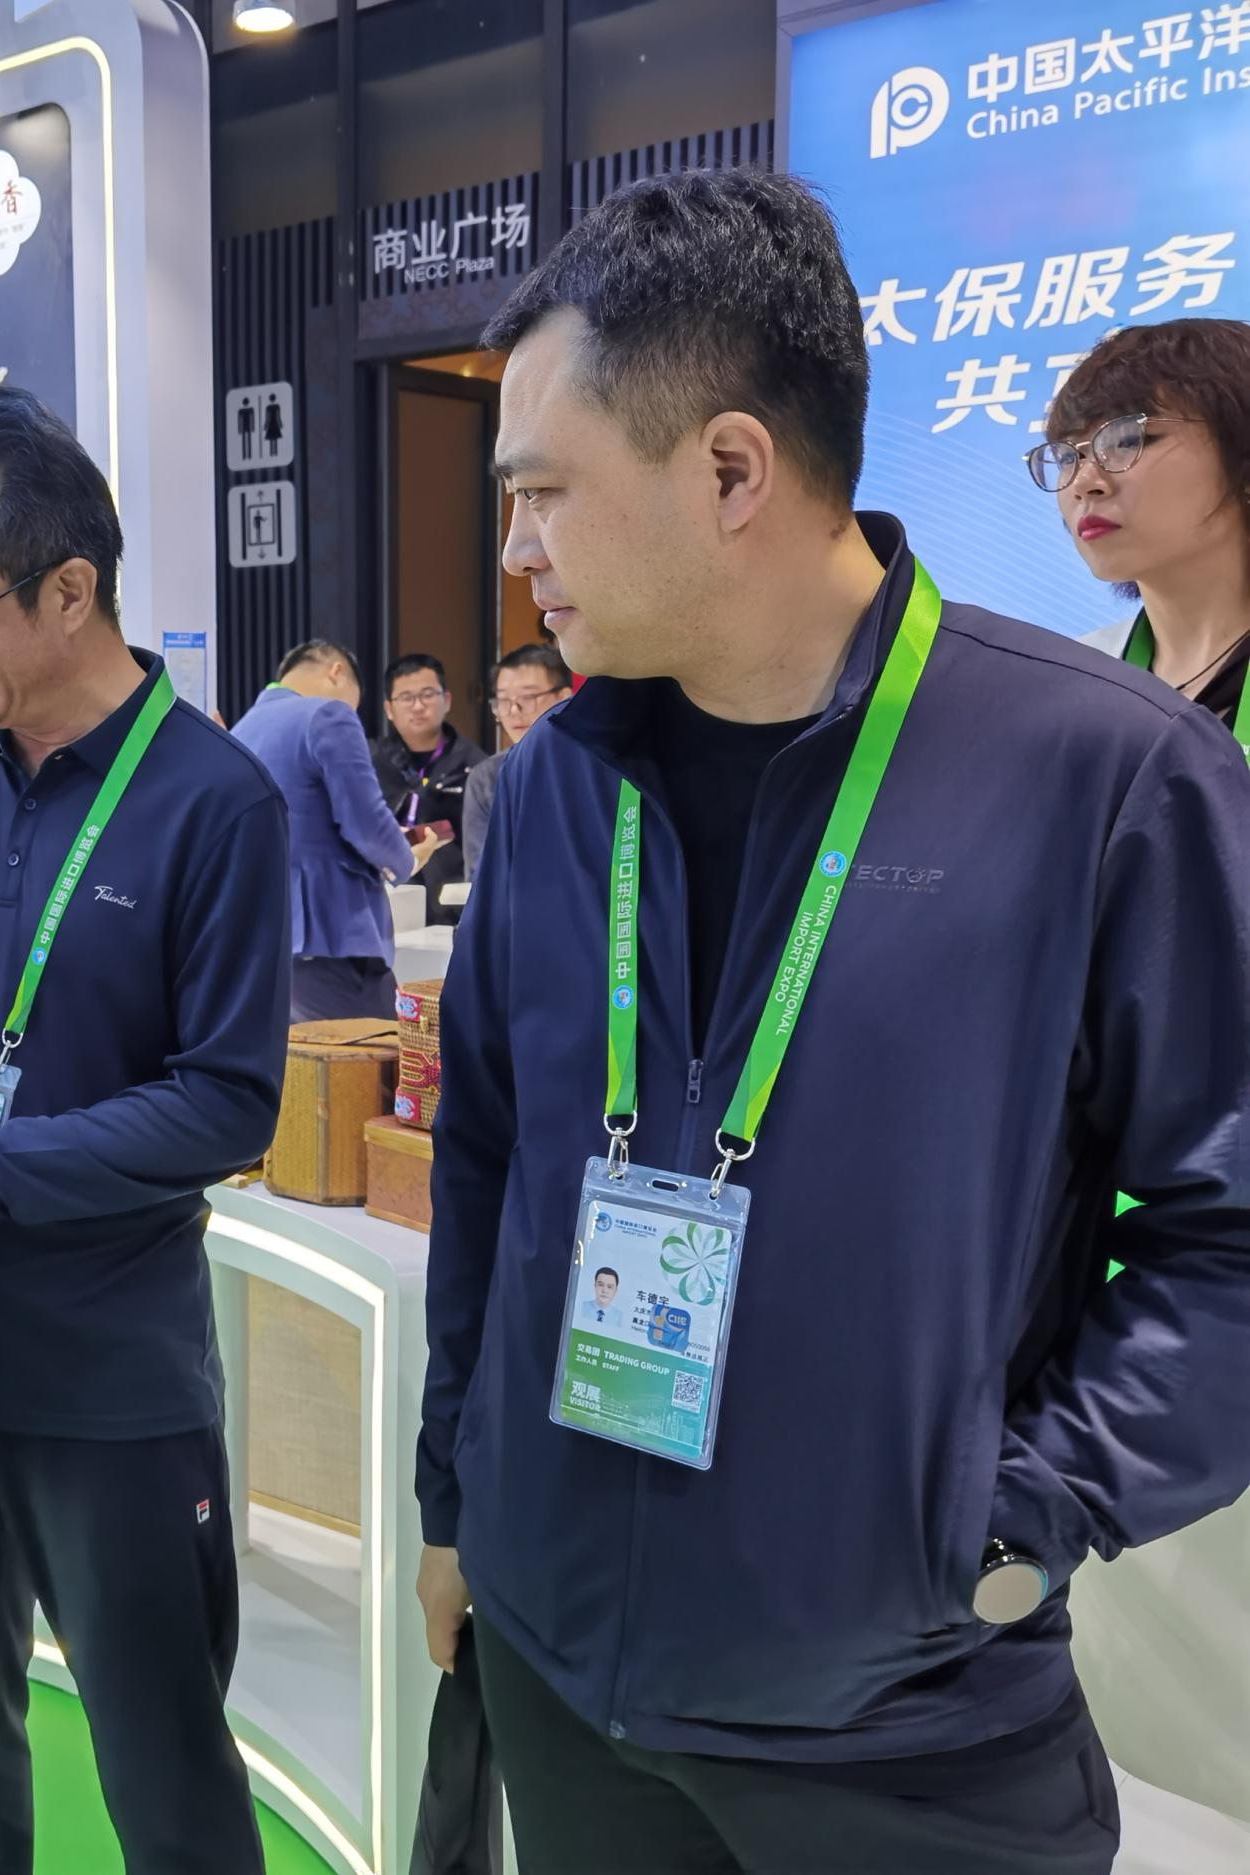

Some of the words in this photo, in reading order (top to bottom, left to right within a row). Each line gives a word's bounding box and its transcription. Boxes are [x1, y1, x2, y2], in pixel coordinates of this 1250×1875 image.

[967, 2, 1250, 103] 中国太平洋
[966, 103, 1059, 139] China
[1074, 77, 1189, 120] Pacific
[373, 203, 530, 274] 商业广场
[404, 262, 450, 285] NECC
[455, 256, 495, 275] Plaza
[860, 232, 1236, 346] 太保服务
[40, 824, 100, 945] 中国国际进口博览会
[615, 806, 638, 980] 中国国际进口博览会
[851, 864, 945, 885] ECTOP
[94, 885, 137, 910] Talented
[812, 885, 837, 927] CHINA
[788, 911, 814, 965] IMPORT
[775, 966, 795, 1003] EXPO
[776, 931, 822, 1036] INTERNATIONAL
[637, 1290, 670, 1305] 车德宇
[577, 1343, 601, 1357] 交易团
[604, 1350, 640, 1368] TRADING
[640, 1361, 671, 1376] GROUP
[602, 1362, 620, 1372] STAFF
[570, 1396, 602, 1412] VISITOR
[571, 1380, 601, 1403] 观展
